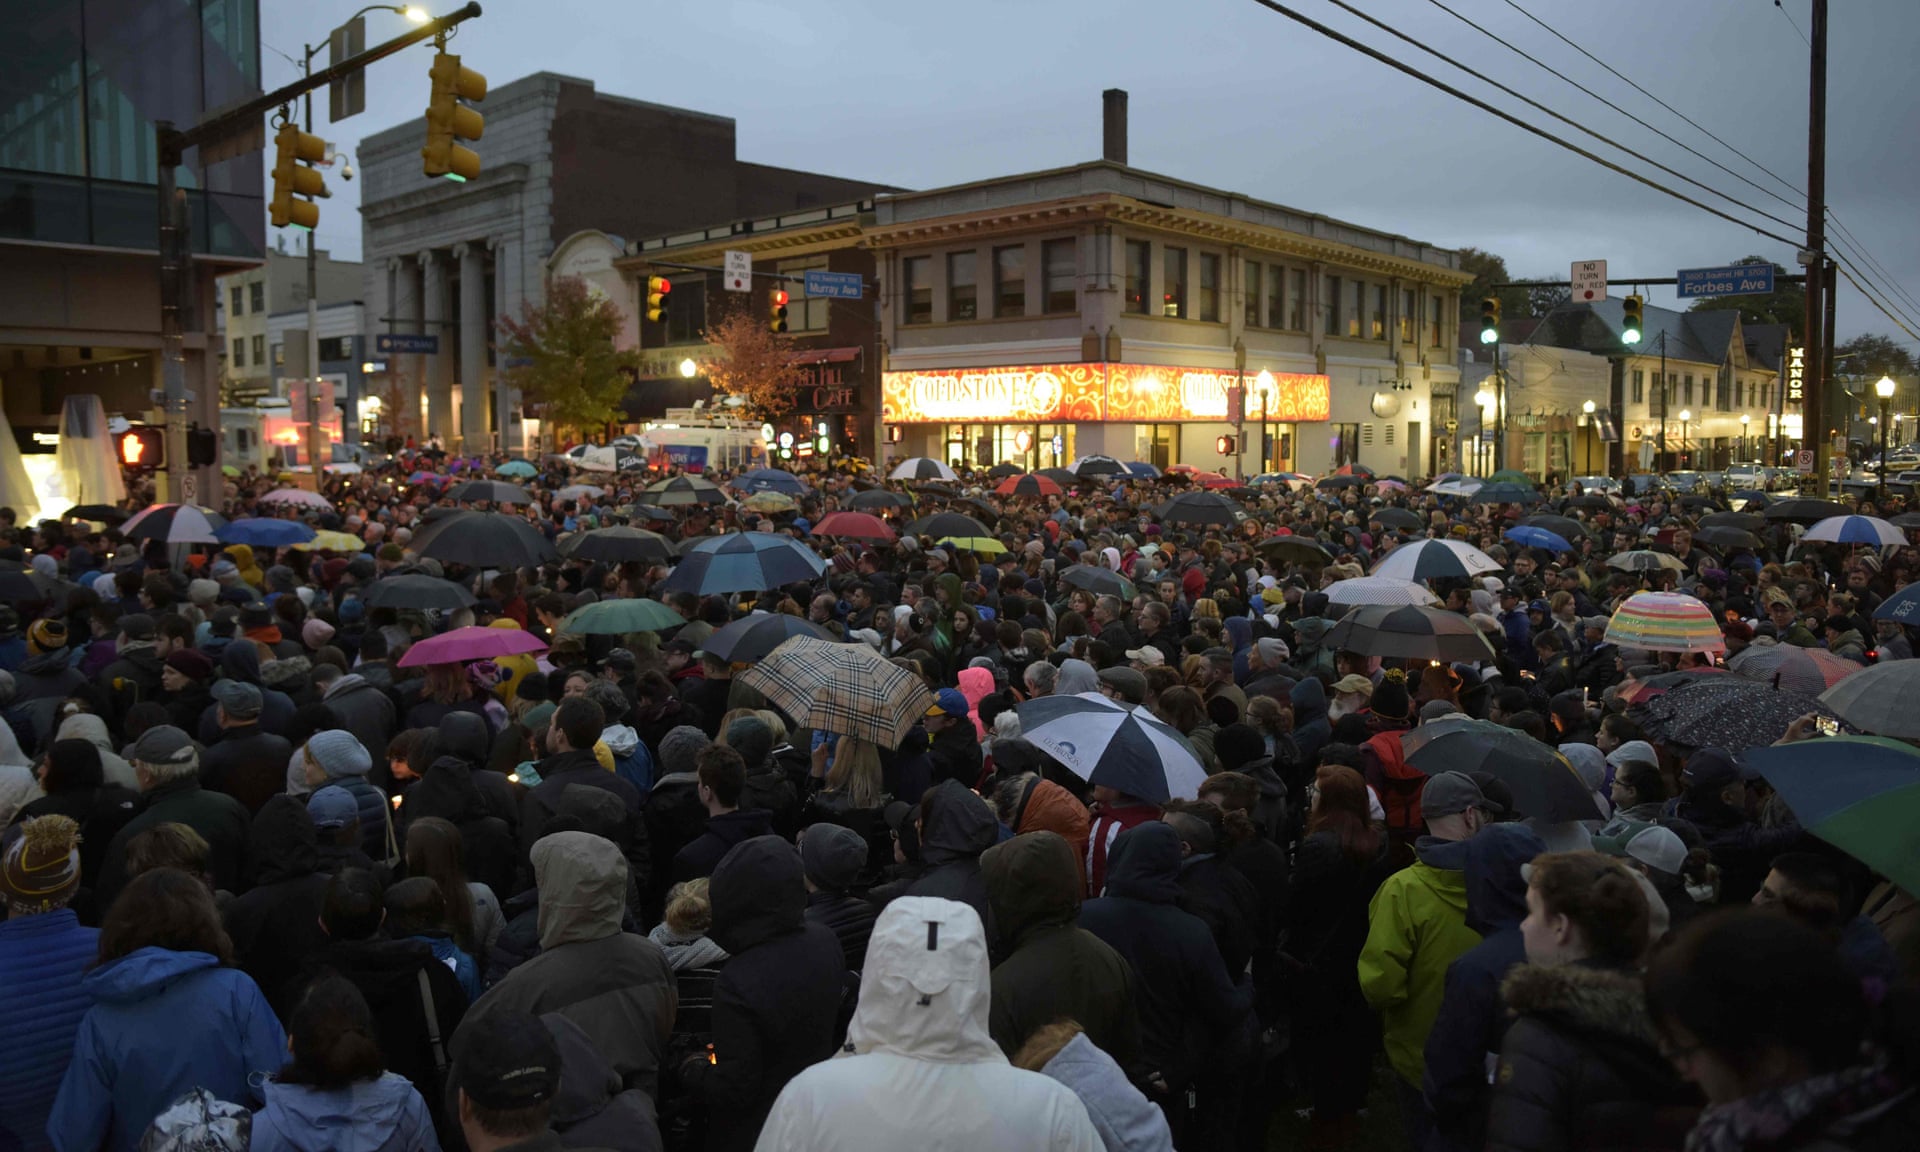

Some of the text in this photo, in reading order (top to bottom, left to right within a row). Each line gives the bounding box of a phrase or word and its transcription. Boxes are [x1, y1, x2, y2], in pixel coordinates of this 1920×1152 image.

[1583, 263, 1595, 271] NO
[1579, 272, 1599, 280] TURN
[809, 282, 858, 296] Murray Ave
[1573, 281, 1605, 290] ON RED
[1684, 278, 1766, 294] Forbes Ave
[1790, 347, 1804, 399] MANOR
[911, 376, 961, 410] COLD
[961, 373, 1027, 410] STONE
[670, 453, 688, 464] NEWS
